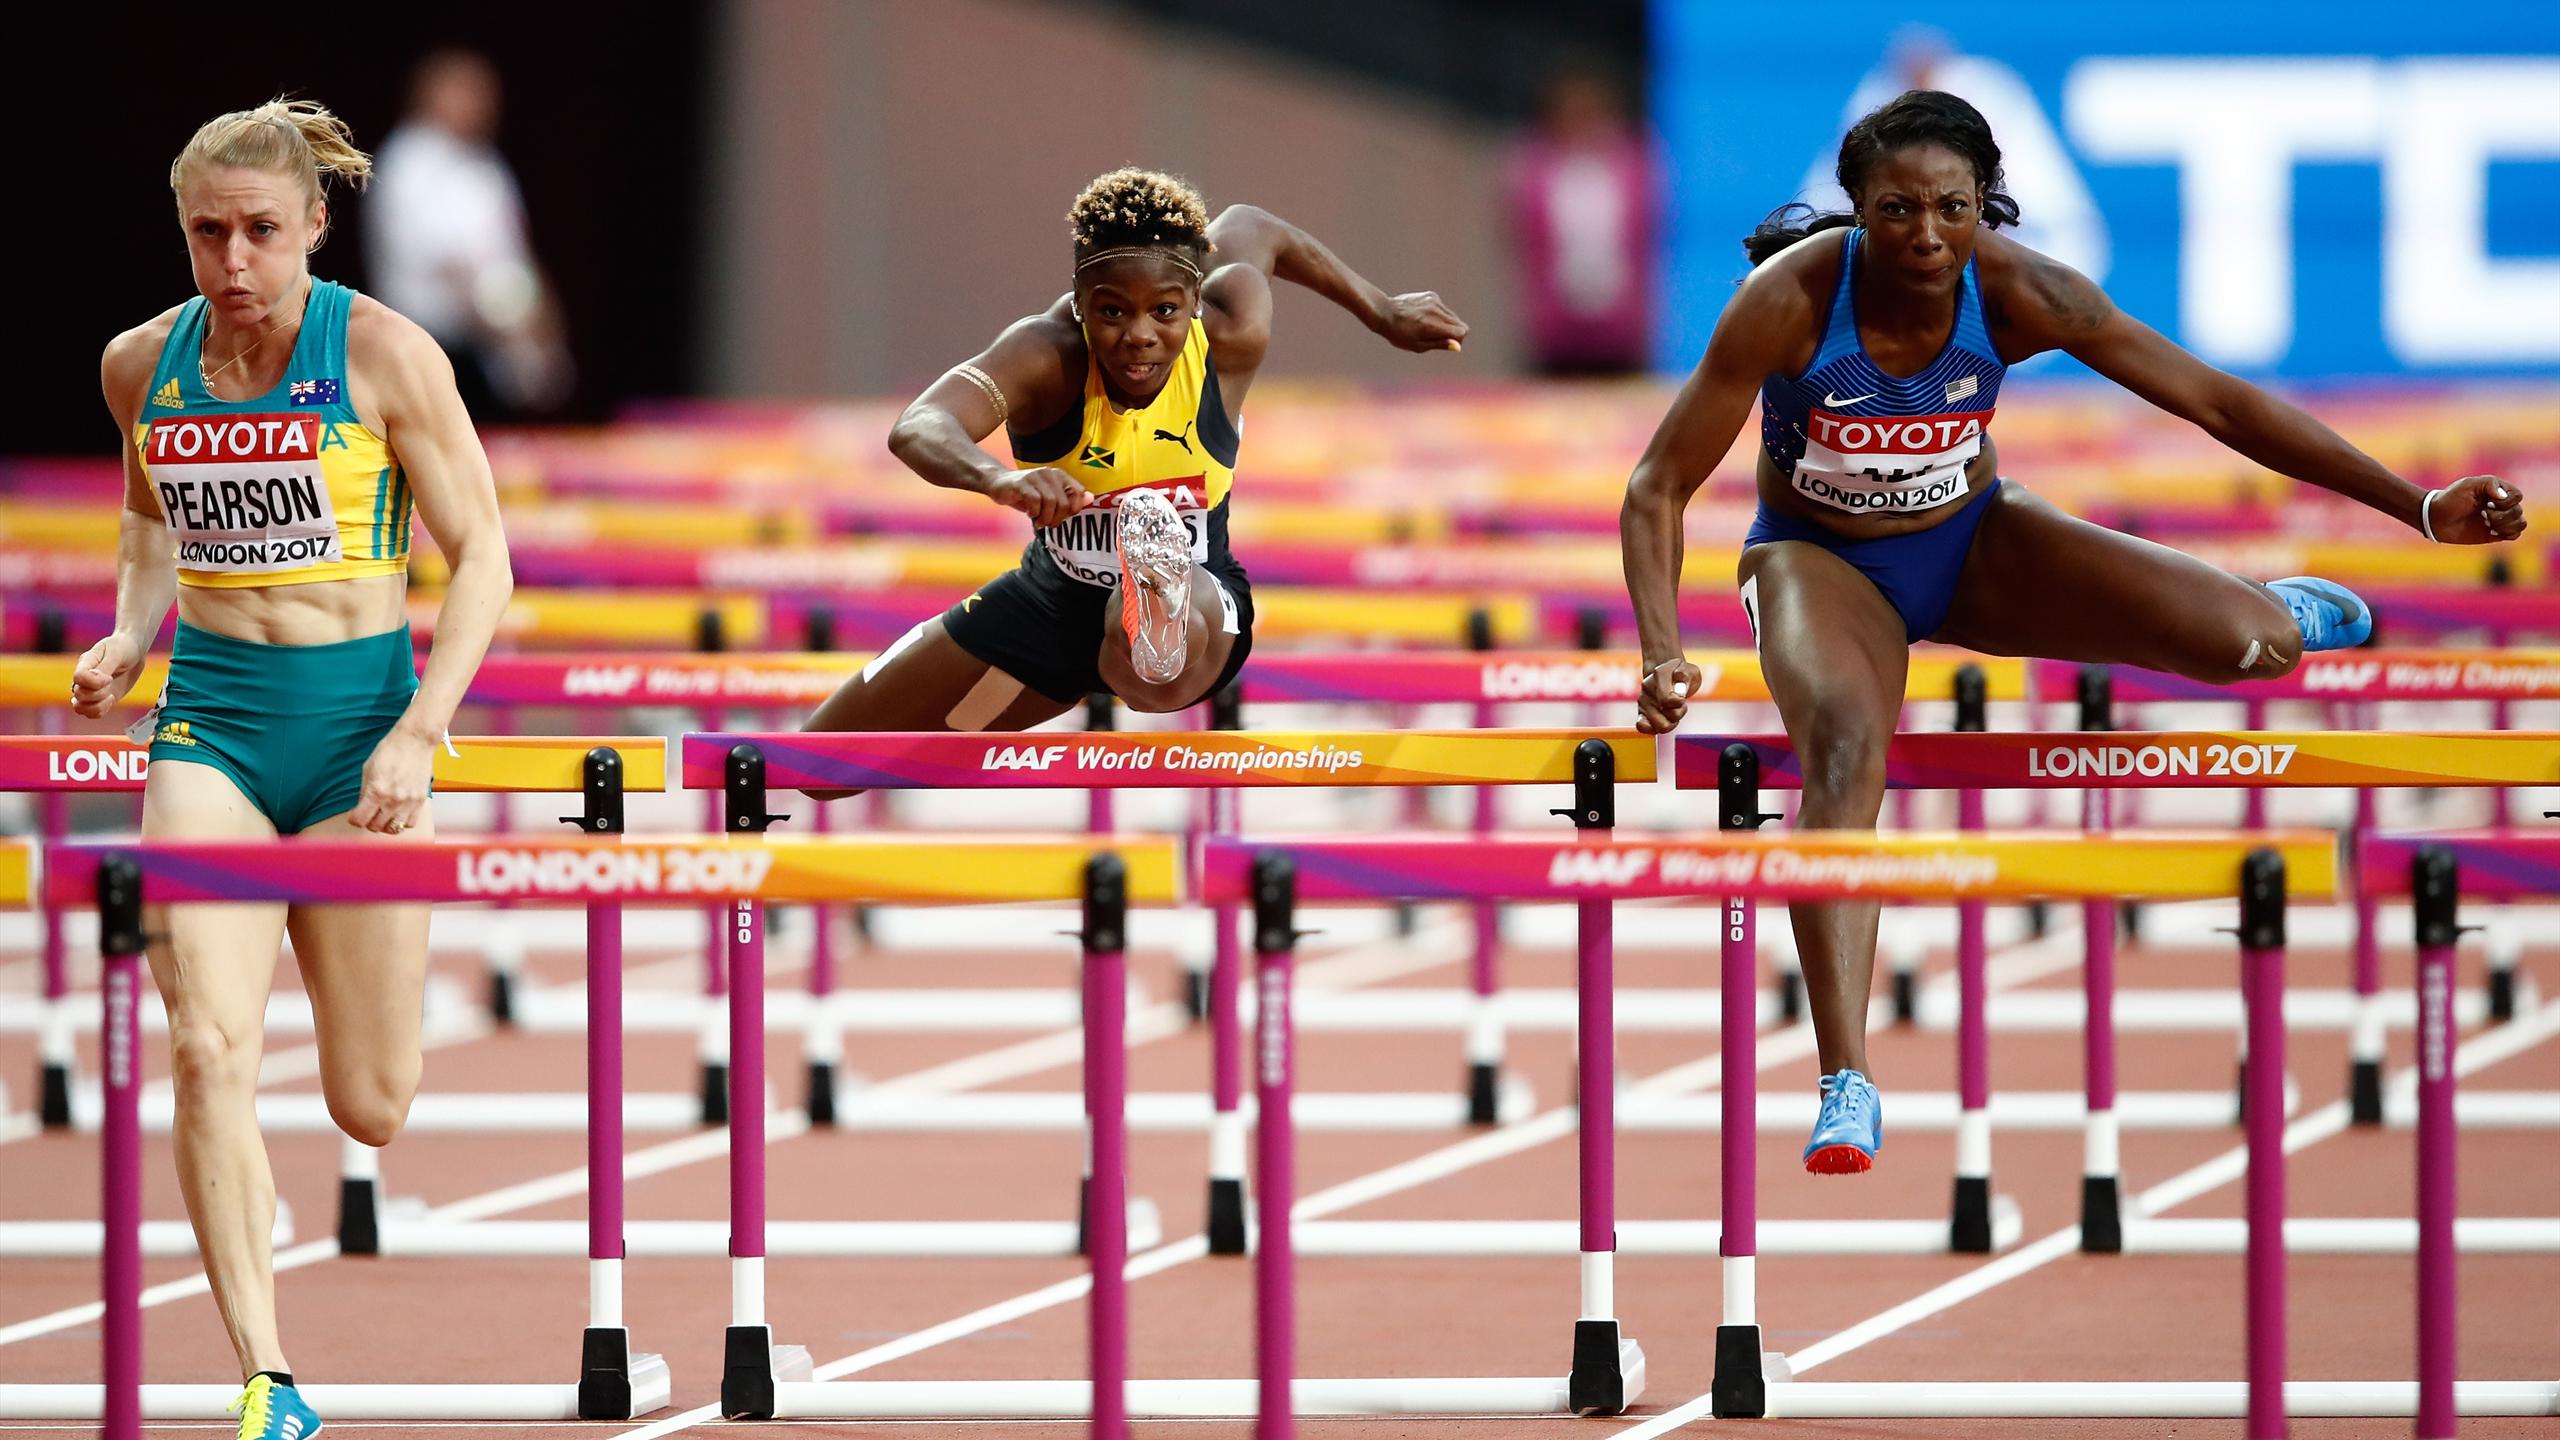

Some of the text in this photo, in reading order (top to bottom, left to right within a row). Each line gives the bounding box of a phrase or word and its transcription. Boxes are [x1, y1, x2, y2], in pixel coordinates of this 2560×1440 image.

[152, 396, 184, 409] adidas
[155, 421, 309, 457] TOYOTA
[1815, 415, 1981, 449] TOYOTA
[160, 475, 322, 530] PEARSON
[1799, 472, 1908, 508] LONDON
[181, 536, 331, 564] LONDON 2017
[1481, 664, 1639, 699] LONDON
[156, 732, 197, 747] adidas
[50, 750, 149, 782] LOND
[981, 745, 1364, 775] IAAF World Championships
[2029, 744, 2298, 777] LONDON 2017
[457, 848, 775, 893] LONDON 2017
[1657, 848, 1759, 886] World
